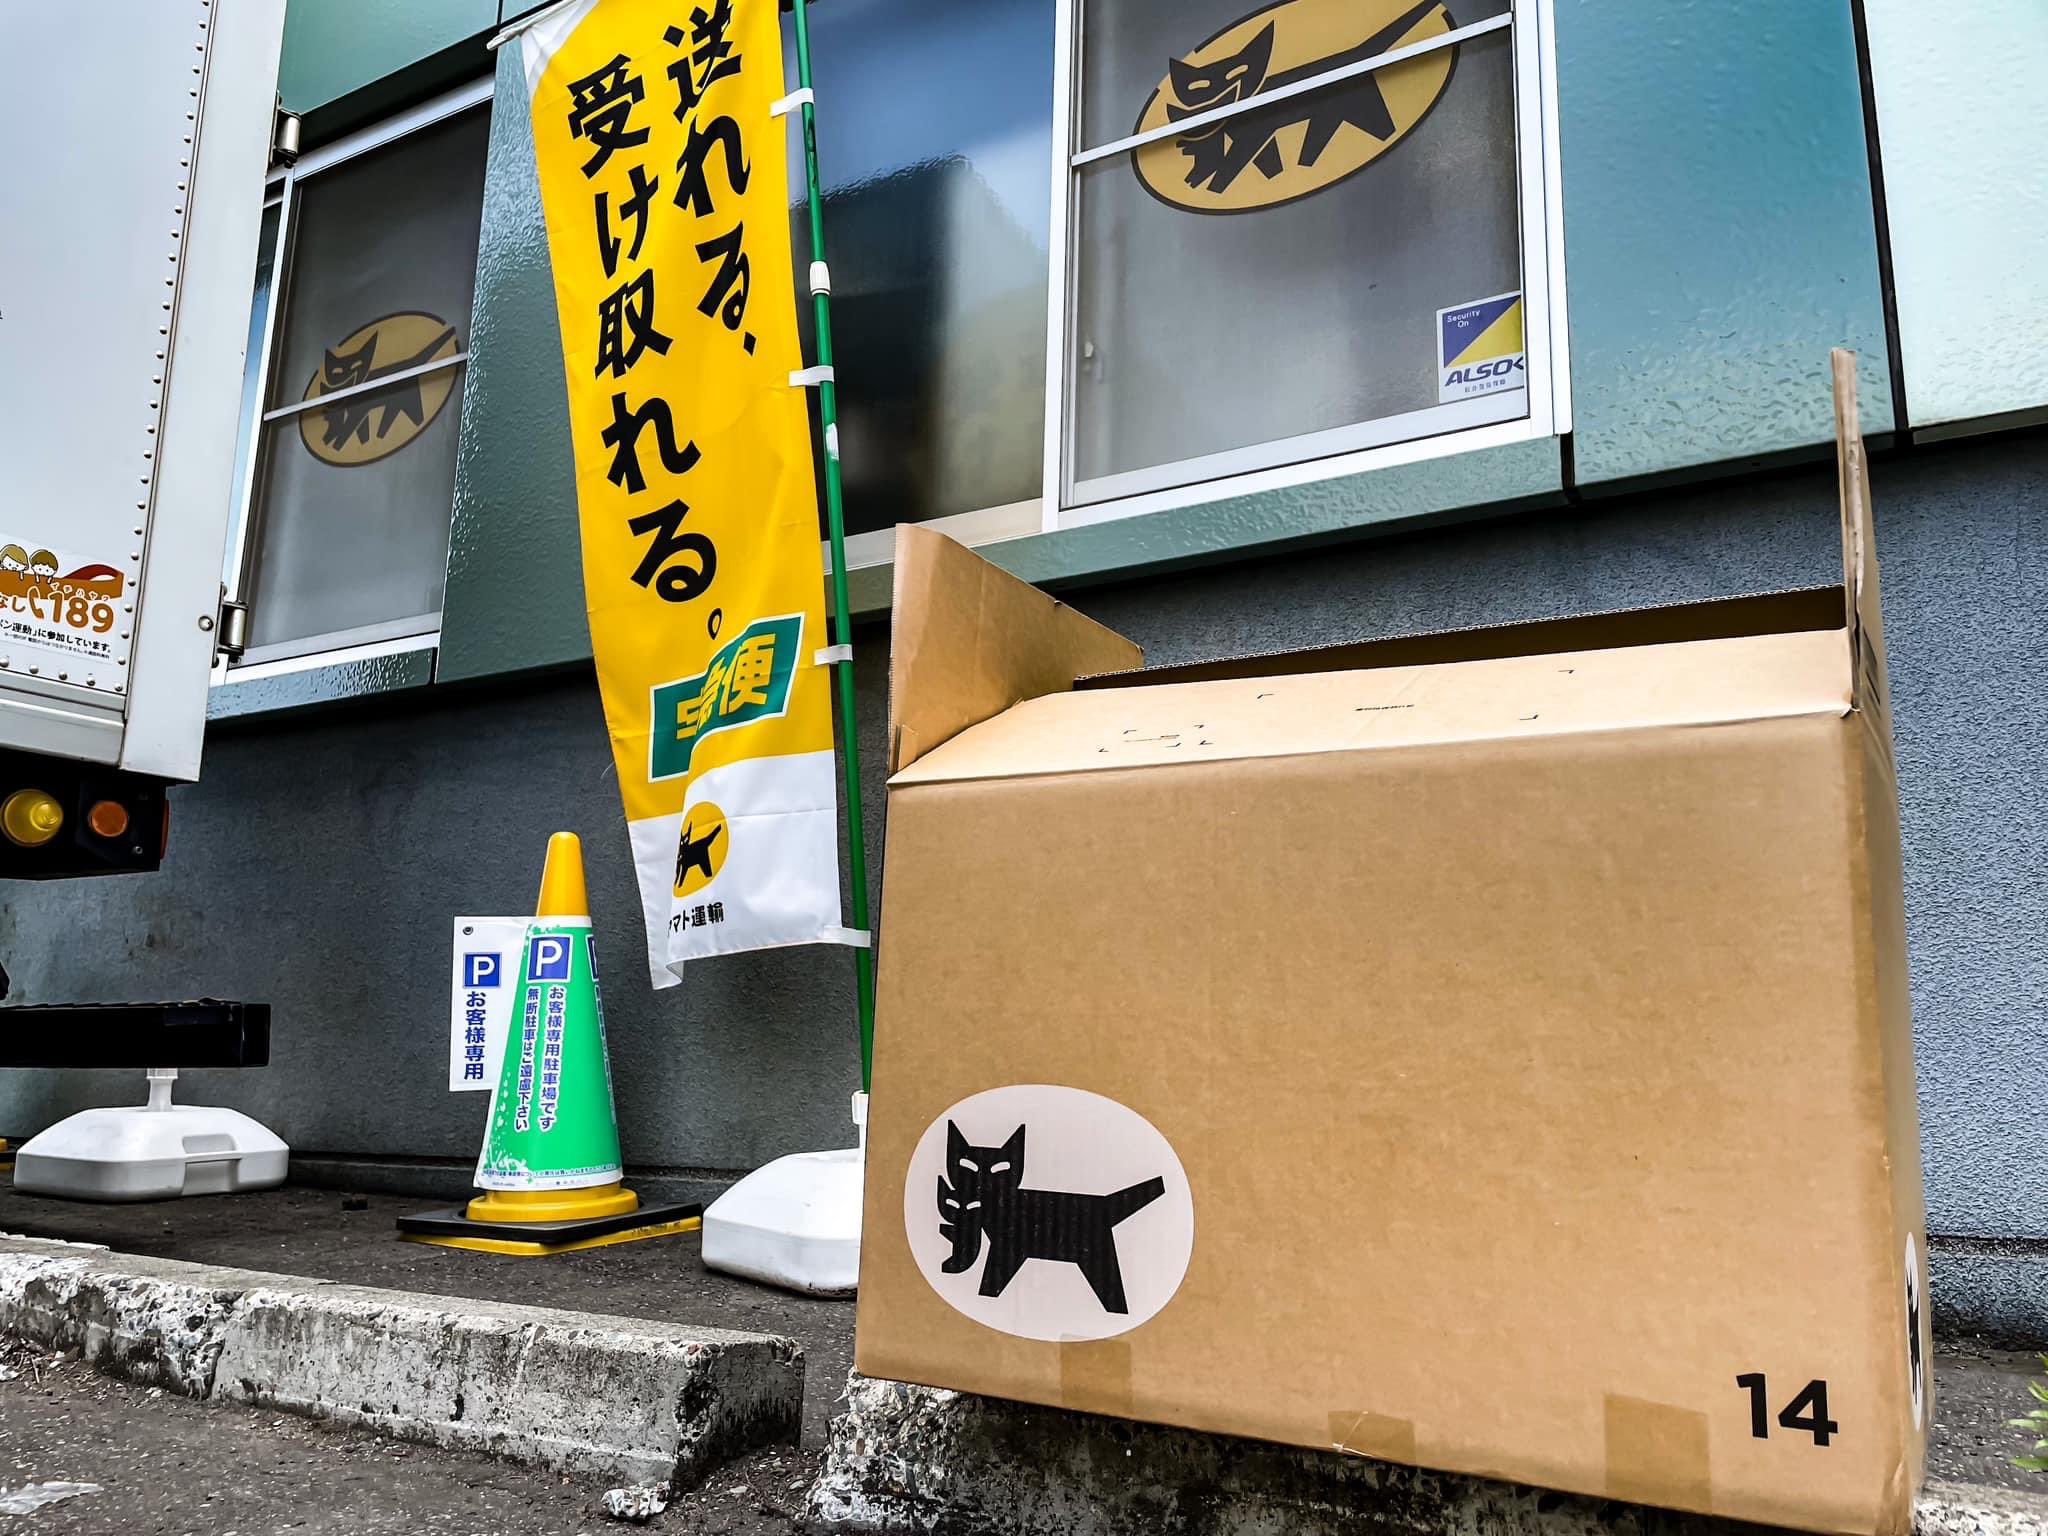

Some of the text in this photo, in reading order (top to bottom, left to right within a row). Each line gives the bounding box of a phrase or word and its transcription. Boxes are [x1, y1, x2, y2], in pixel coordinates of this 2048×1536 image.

[1447, 310, 1481, 323] Security
[1457, 320, 1470, 328] On
[566, 53, 722, 640] 受け取れる。
[48, 592, 114, 633] 189
[0, 619, 111, 653] ン運動」に参加しています。
[667, 901, 725, 938] マト運輸
[473, 956, 495, 985] P
[536, 940, 563, 977] P
[464, 991, 486, 1081] お客様専用
[540, 986, 564, 1130] お客様専用駐車場です
[1736, 1372, 1839, 1447] 14
